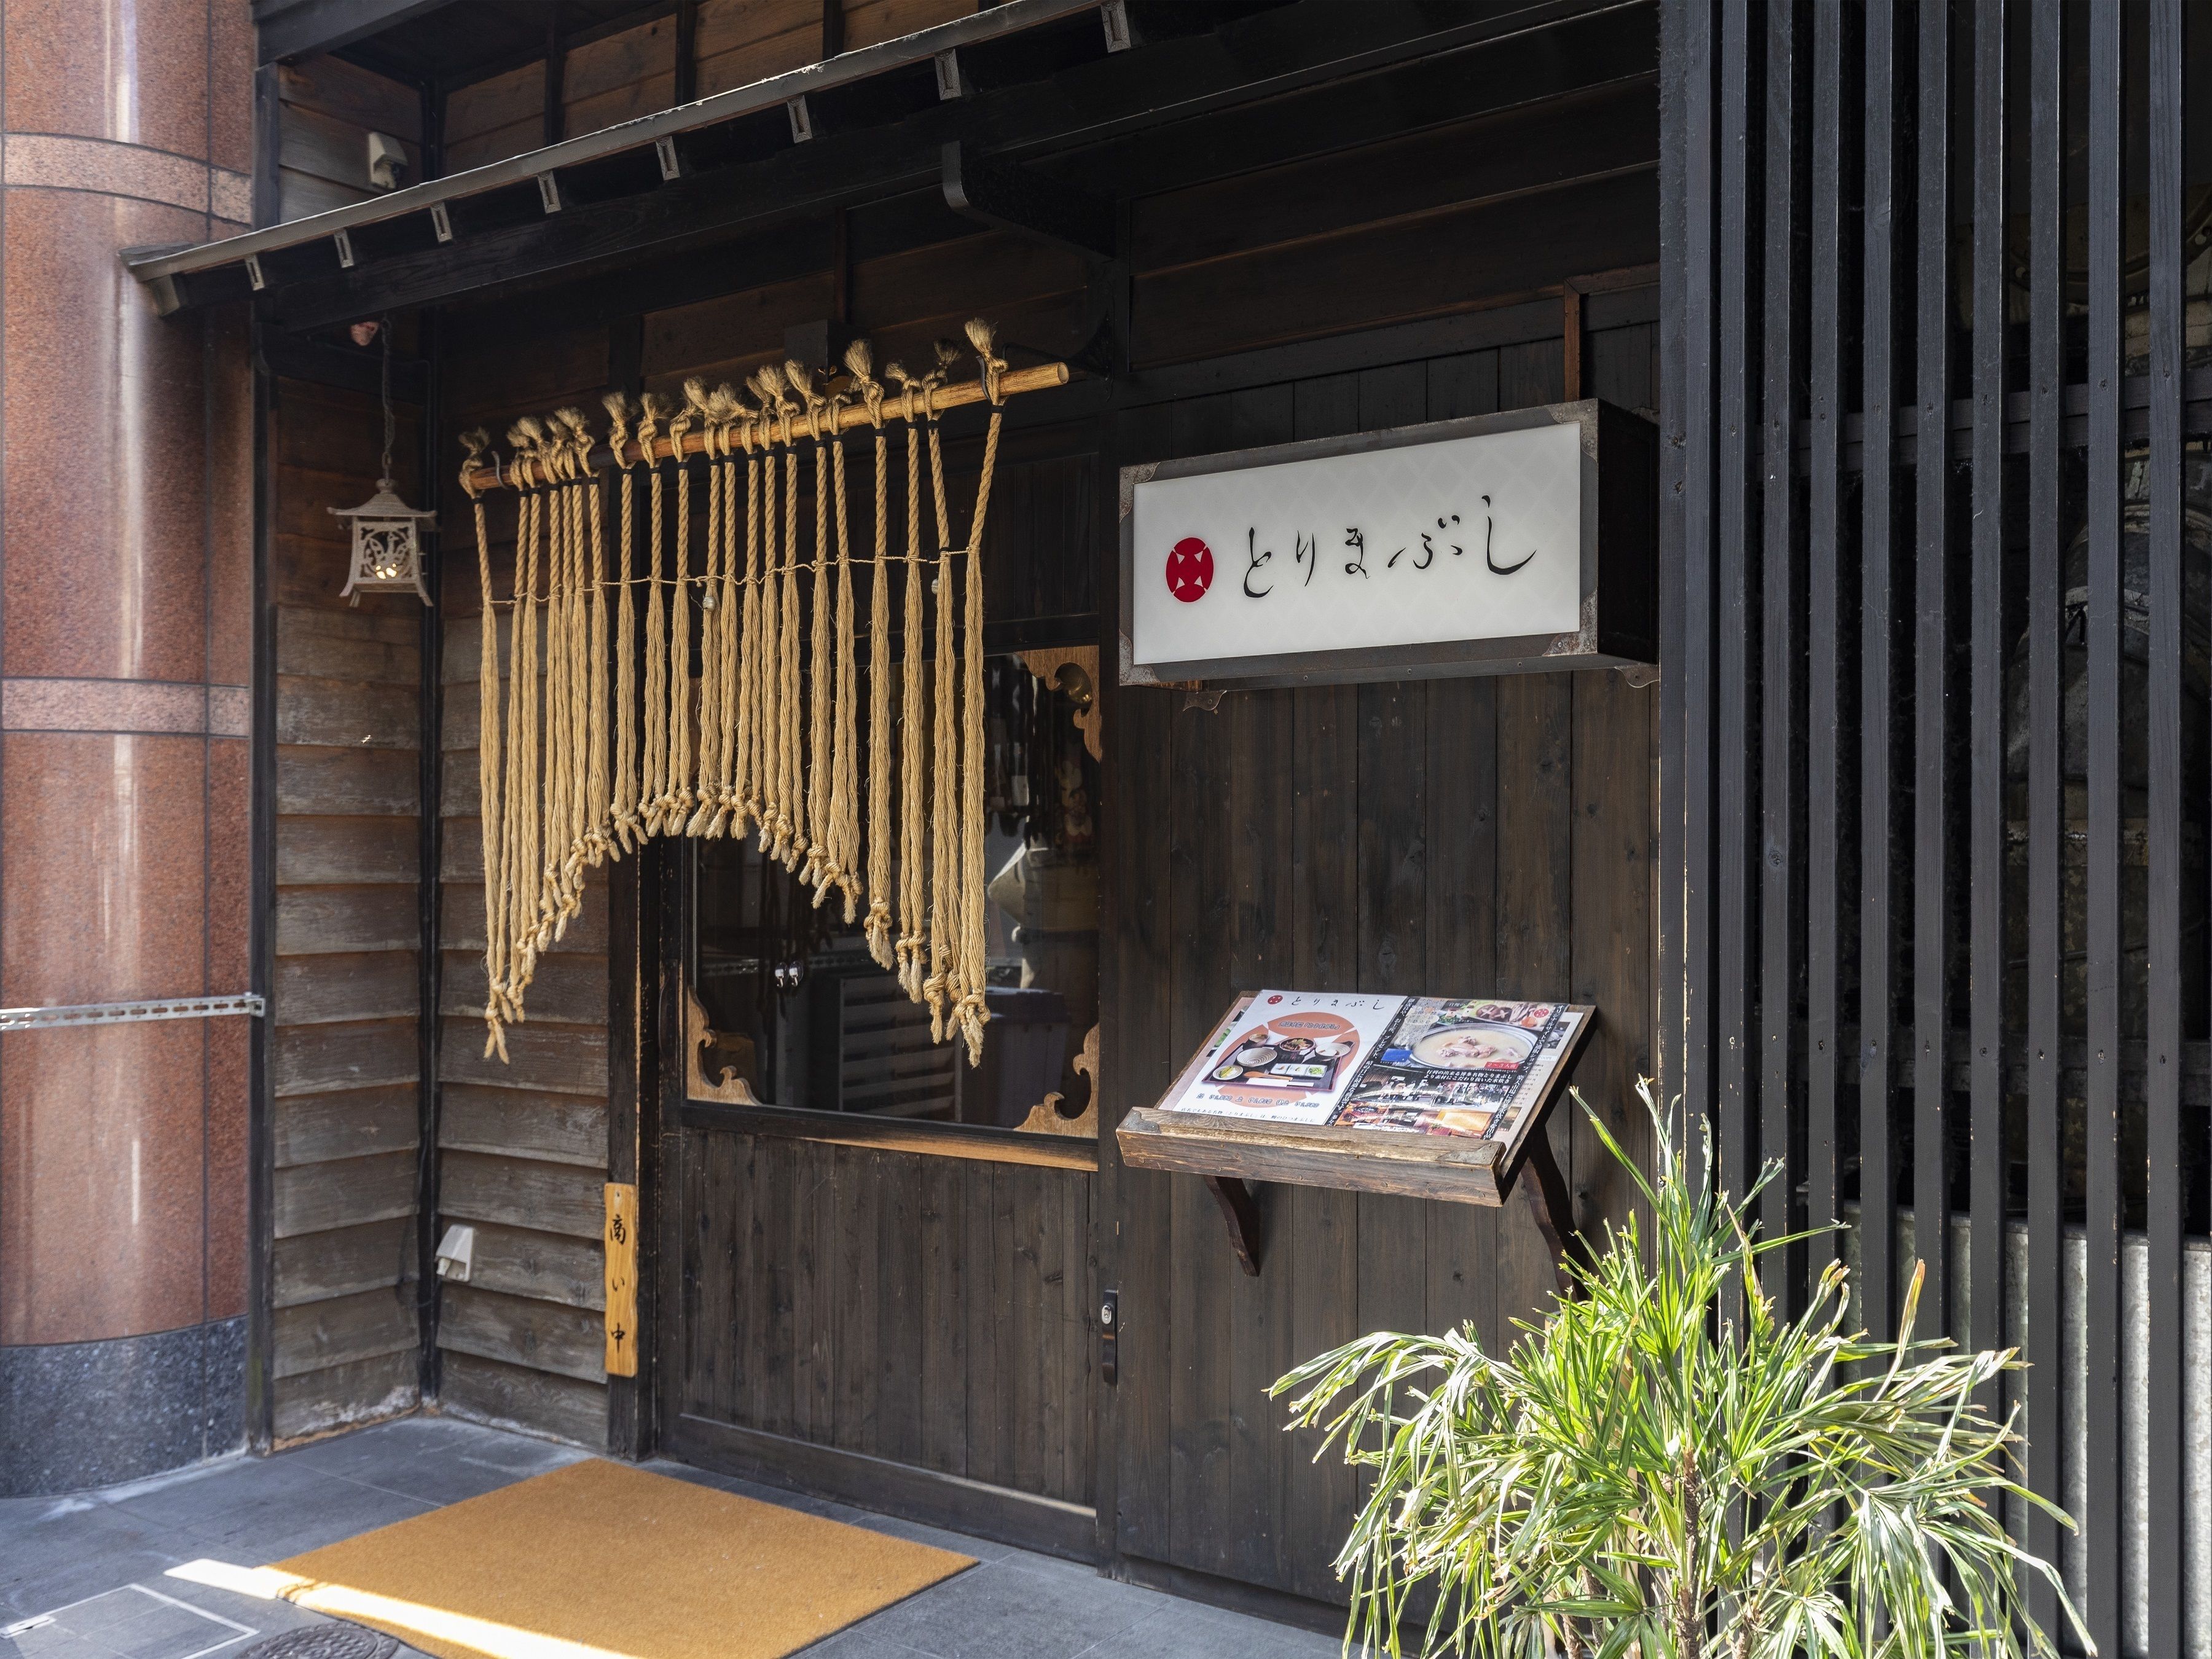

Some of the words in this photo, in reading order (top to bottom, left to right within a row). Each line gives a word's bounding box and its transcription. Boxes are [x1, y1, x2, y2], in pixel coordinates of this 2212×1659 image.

[1243, 495, 1537, 598] とりまぶし
[1292, 995, 1385, 1010] とりまぶし
[610, 1213, 627, 1354] 商い中
